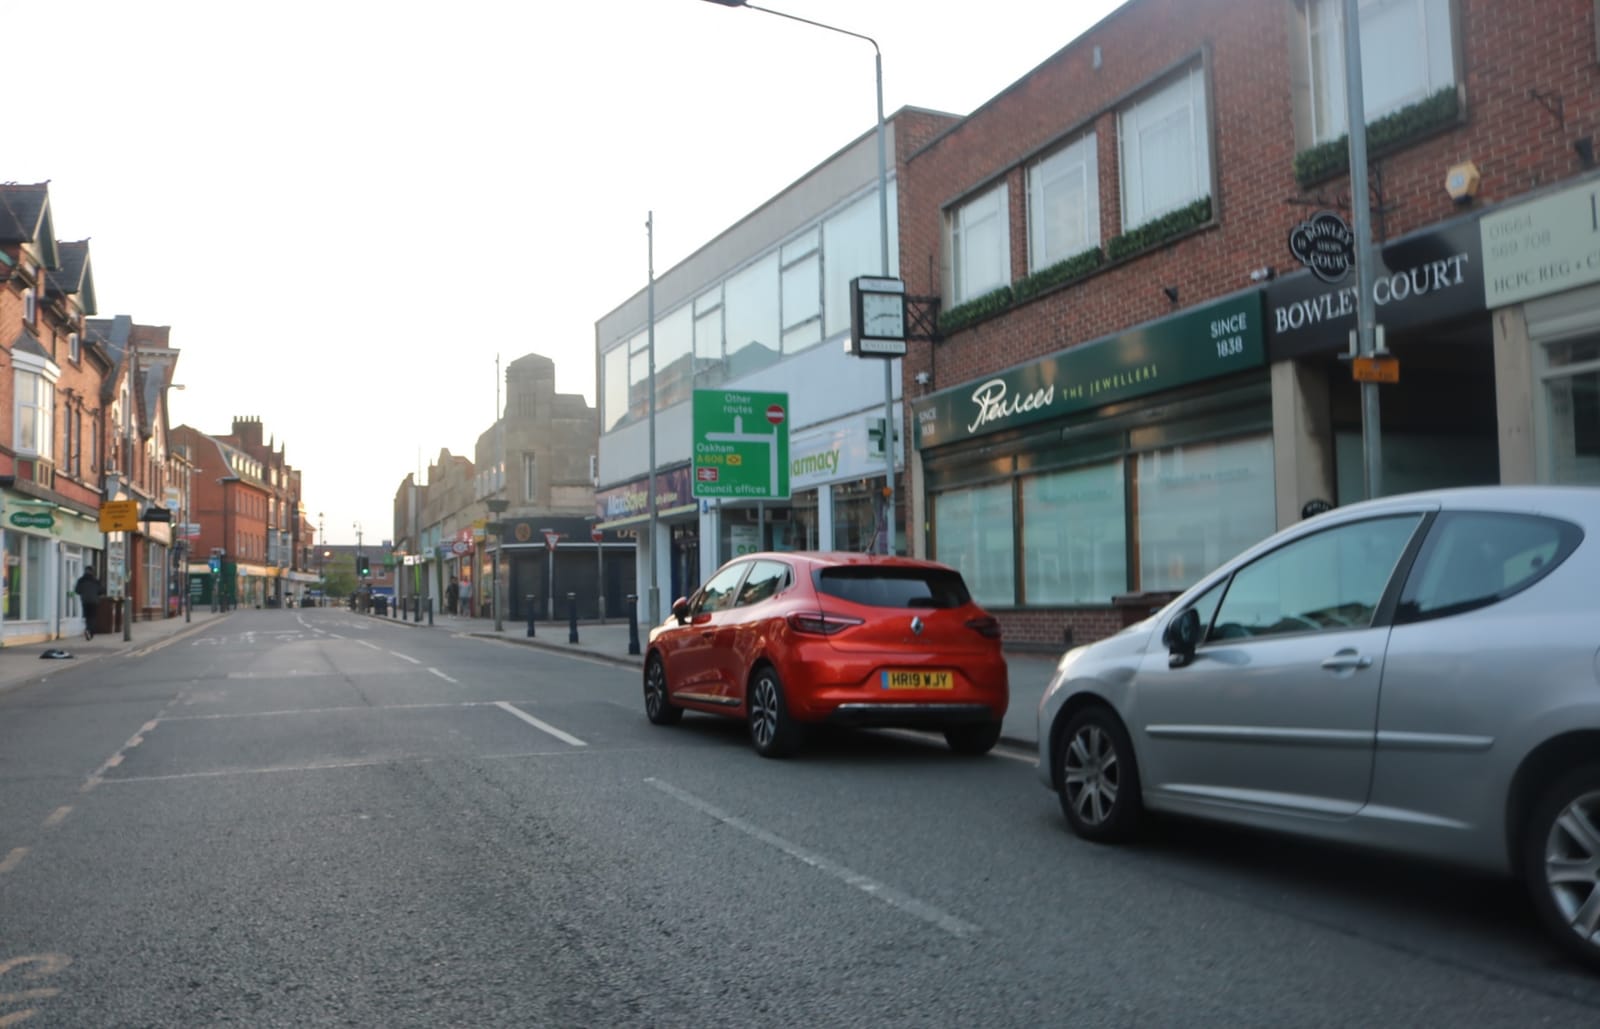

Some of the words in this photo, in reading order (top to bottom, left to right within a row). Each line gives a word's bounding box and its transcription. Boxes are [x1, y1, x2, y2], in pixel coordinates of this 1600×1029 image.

[1304, 221, 1350, 247] BOWLEY
[1310, 250, 1347, 269] COURT
[1372, 252, 1469, 305] COURT
[1210, 311, 1247, 338] SINCE
[1216, 335, 1243, 358] 1838
[725, 393, 751, 403] Other
[967, 378, 1055, 433] Pearces
[1063, 384, 1083, 400] THE
[1090, 363, 1157, 398] JEWELLERS
[723, 405, 753, 414] routes
[696, 443, 735, 453] Oakham
[696, 484, 732, 493] Council
[735, 485, 767, 494] offices
[892, 672, 920, 687] HR19
[923, 672, 947, 686] WJY
